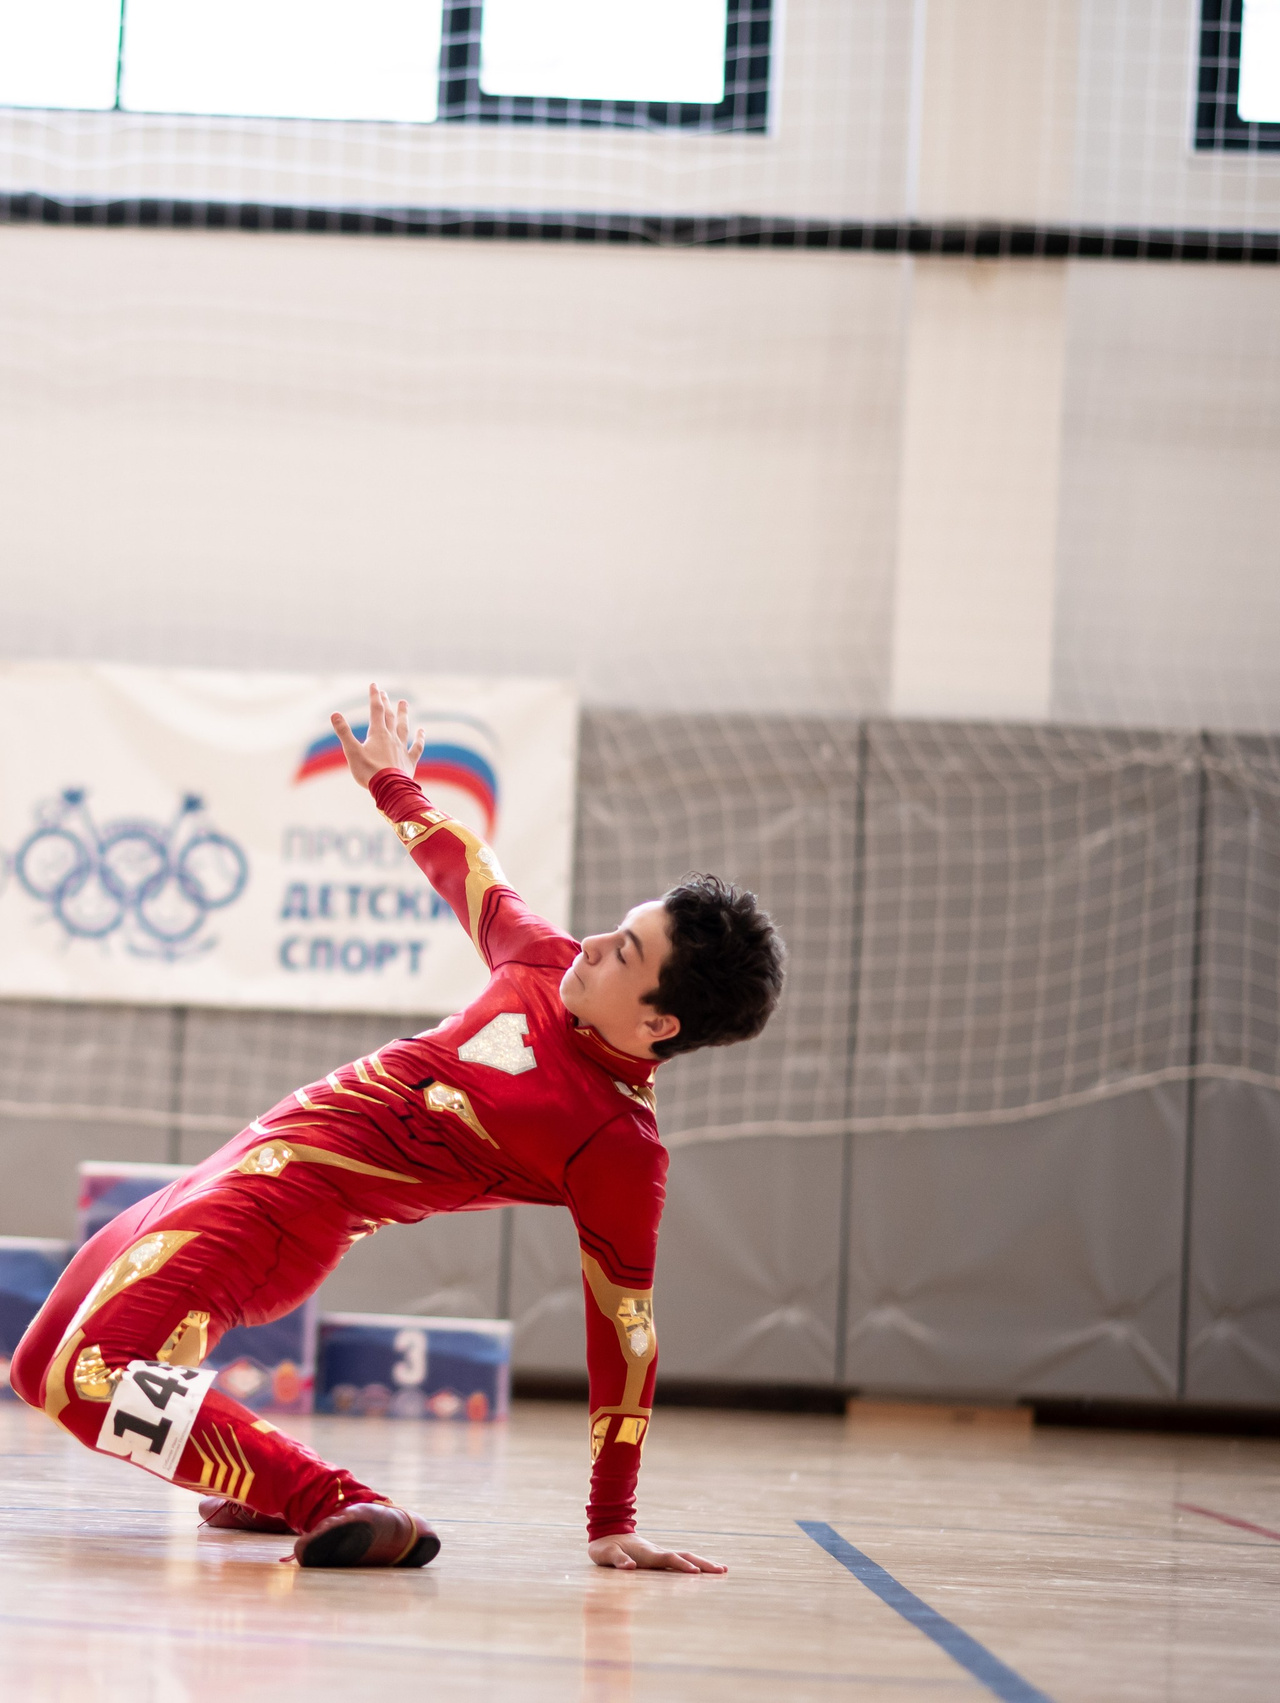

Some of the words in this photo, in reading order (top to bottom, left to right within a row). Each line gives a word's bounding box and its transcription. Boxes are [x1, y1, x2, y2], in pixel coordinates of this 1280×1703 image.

[281, 826, 414, 868] ПРОЕ
[279, 936, 427, 975] СПОРТ
[392, 1327, 428, 1387] 3
